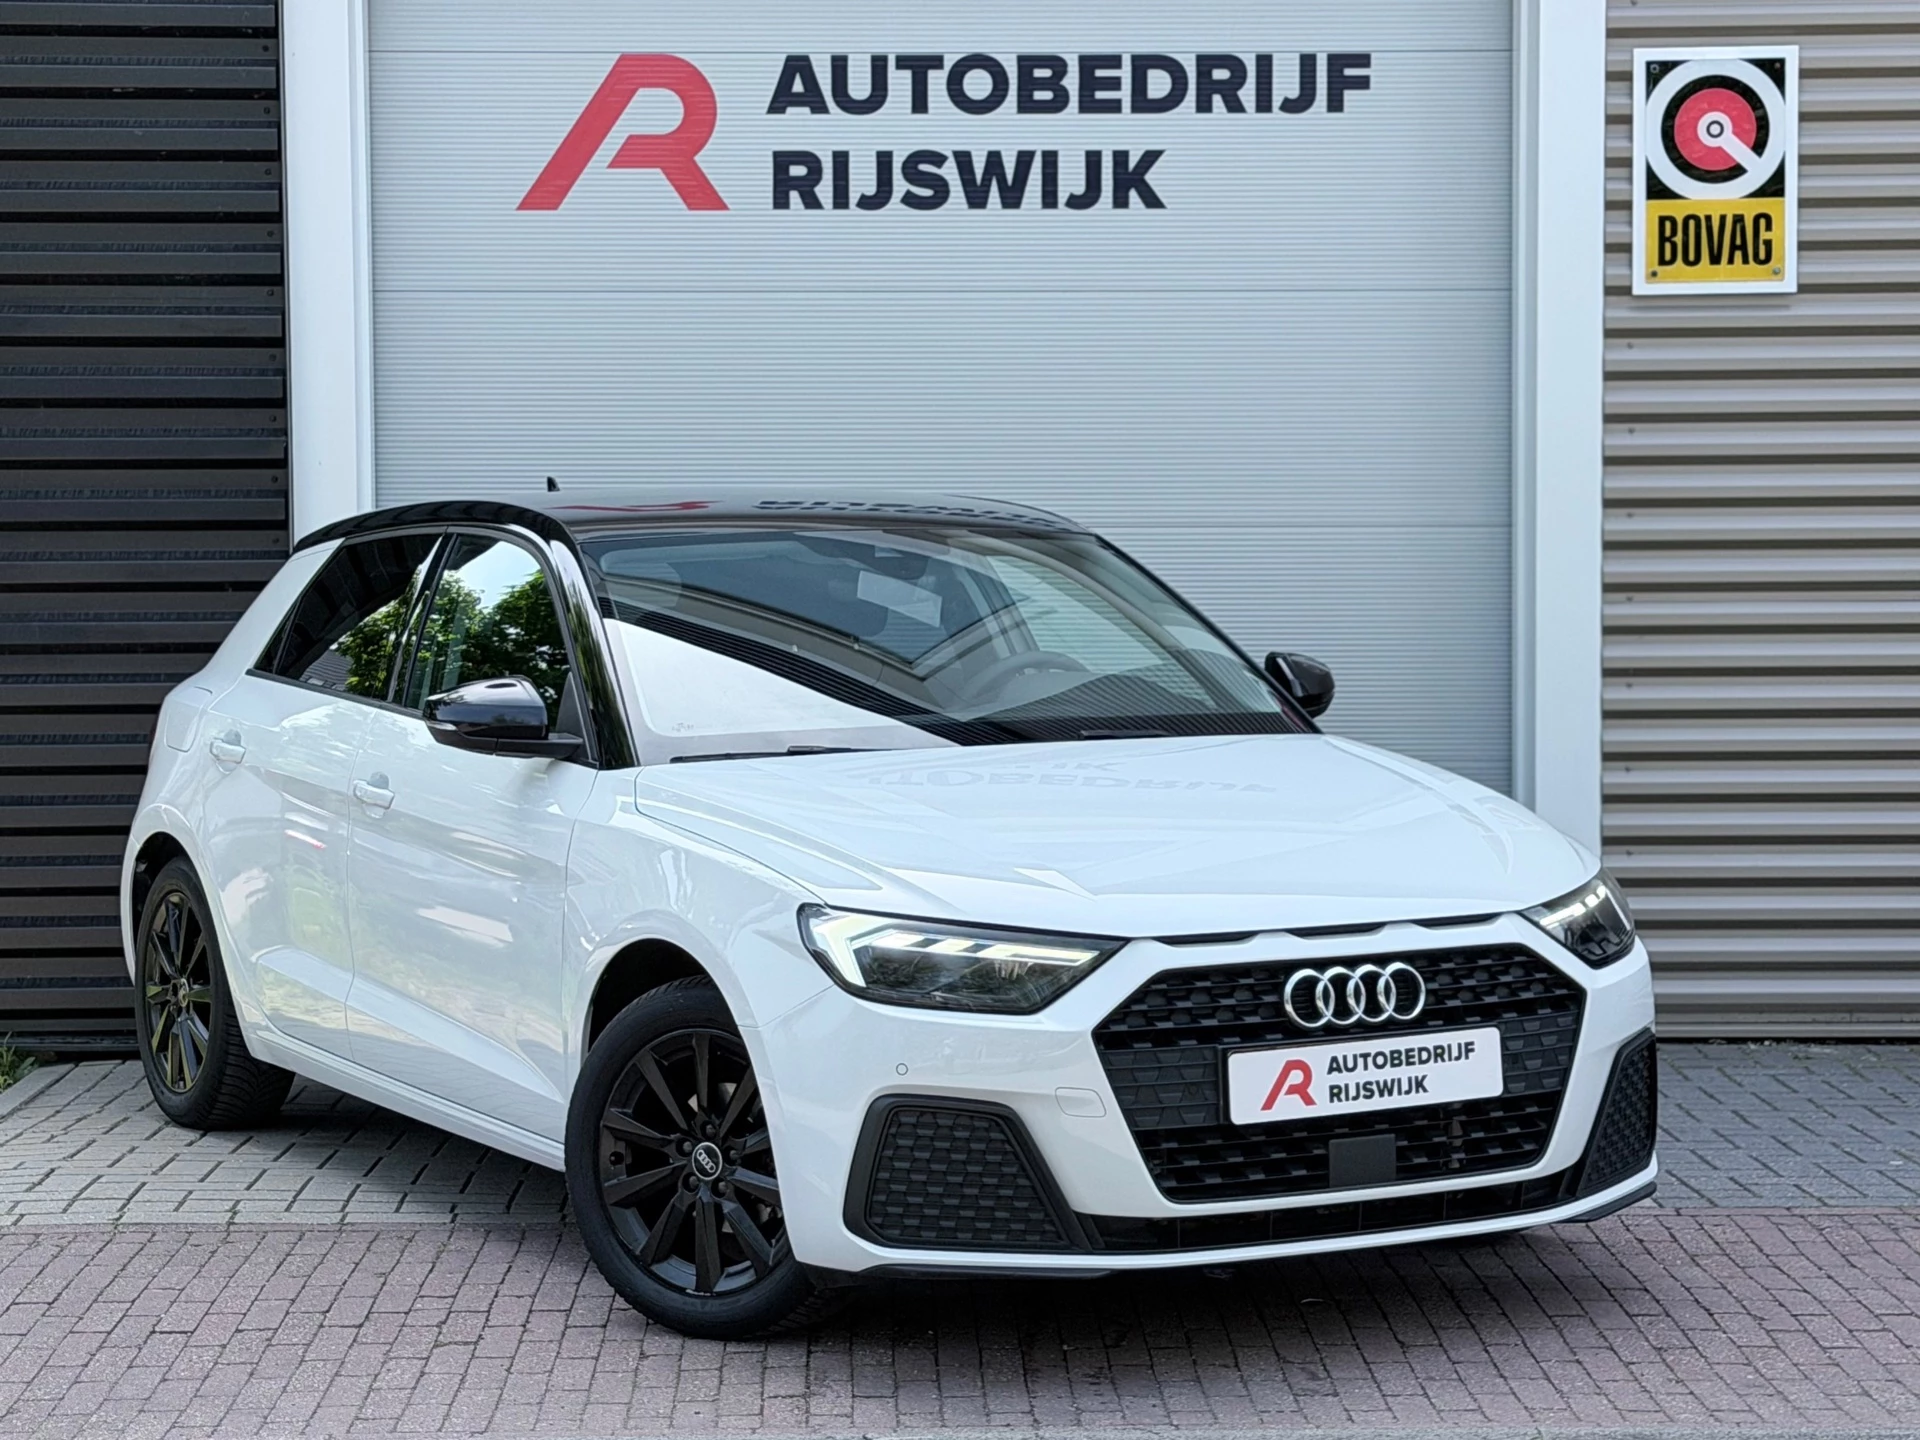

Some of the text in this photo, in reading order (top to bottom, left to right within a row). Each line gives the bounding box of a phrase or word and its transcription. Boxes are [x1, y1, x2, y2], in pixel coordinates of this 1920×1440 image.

[765, 52, 1373, 116] AUTOBEDRIJF
[771, 149, 1167, 212] RIJSWIJK
[1657, 212, 1774, 267] BOVAG
[1326, 1041, 1476, 1076] AUTOBEDRIJF
[1328, 1074, 1430, 1104] RIJSWIJK
